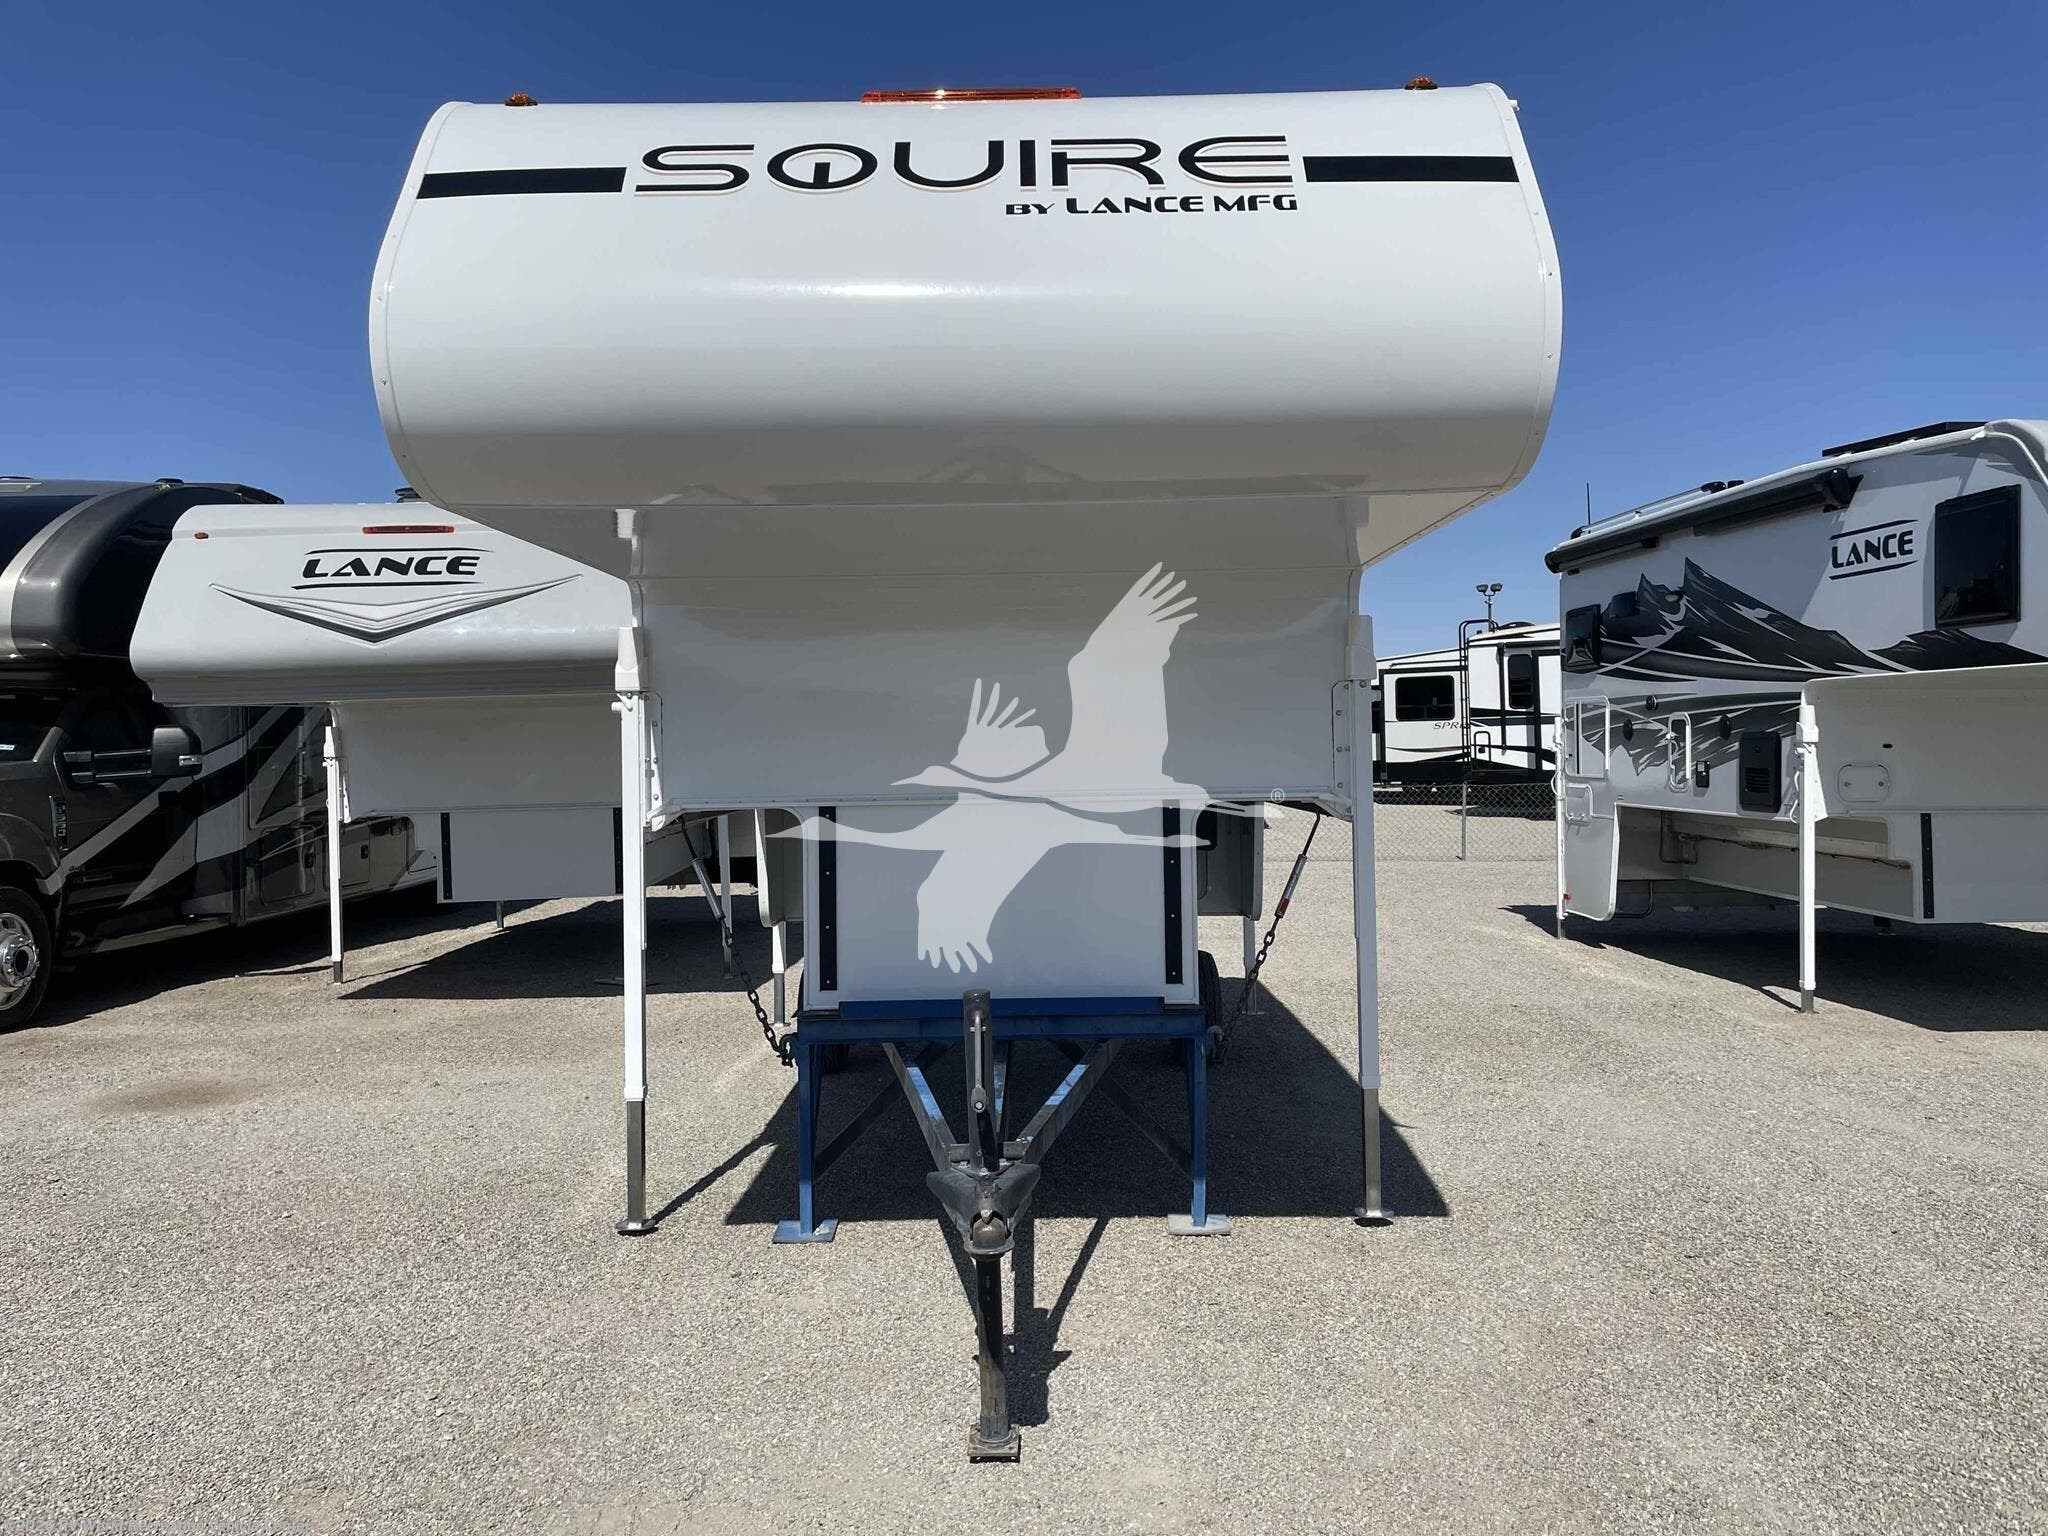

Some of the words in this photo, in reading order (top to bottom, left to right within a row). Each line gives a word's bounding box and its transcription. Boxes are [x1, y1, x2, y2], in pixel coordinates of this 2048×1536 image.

[634, 135, 1294, 193] SQUIRE
[1005, 203, 1054, 215] BY
[1066, 196, 1203, 214] LANCE
[1213, 194, 1297, 212] MFG
[1831, 530, 1914, 569] LANCE
[302, 555, 481, 579] LANCE
